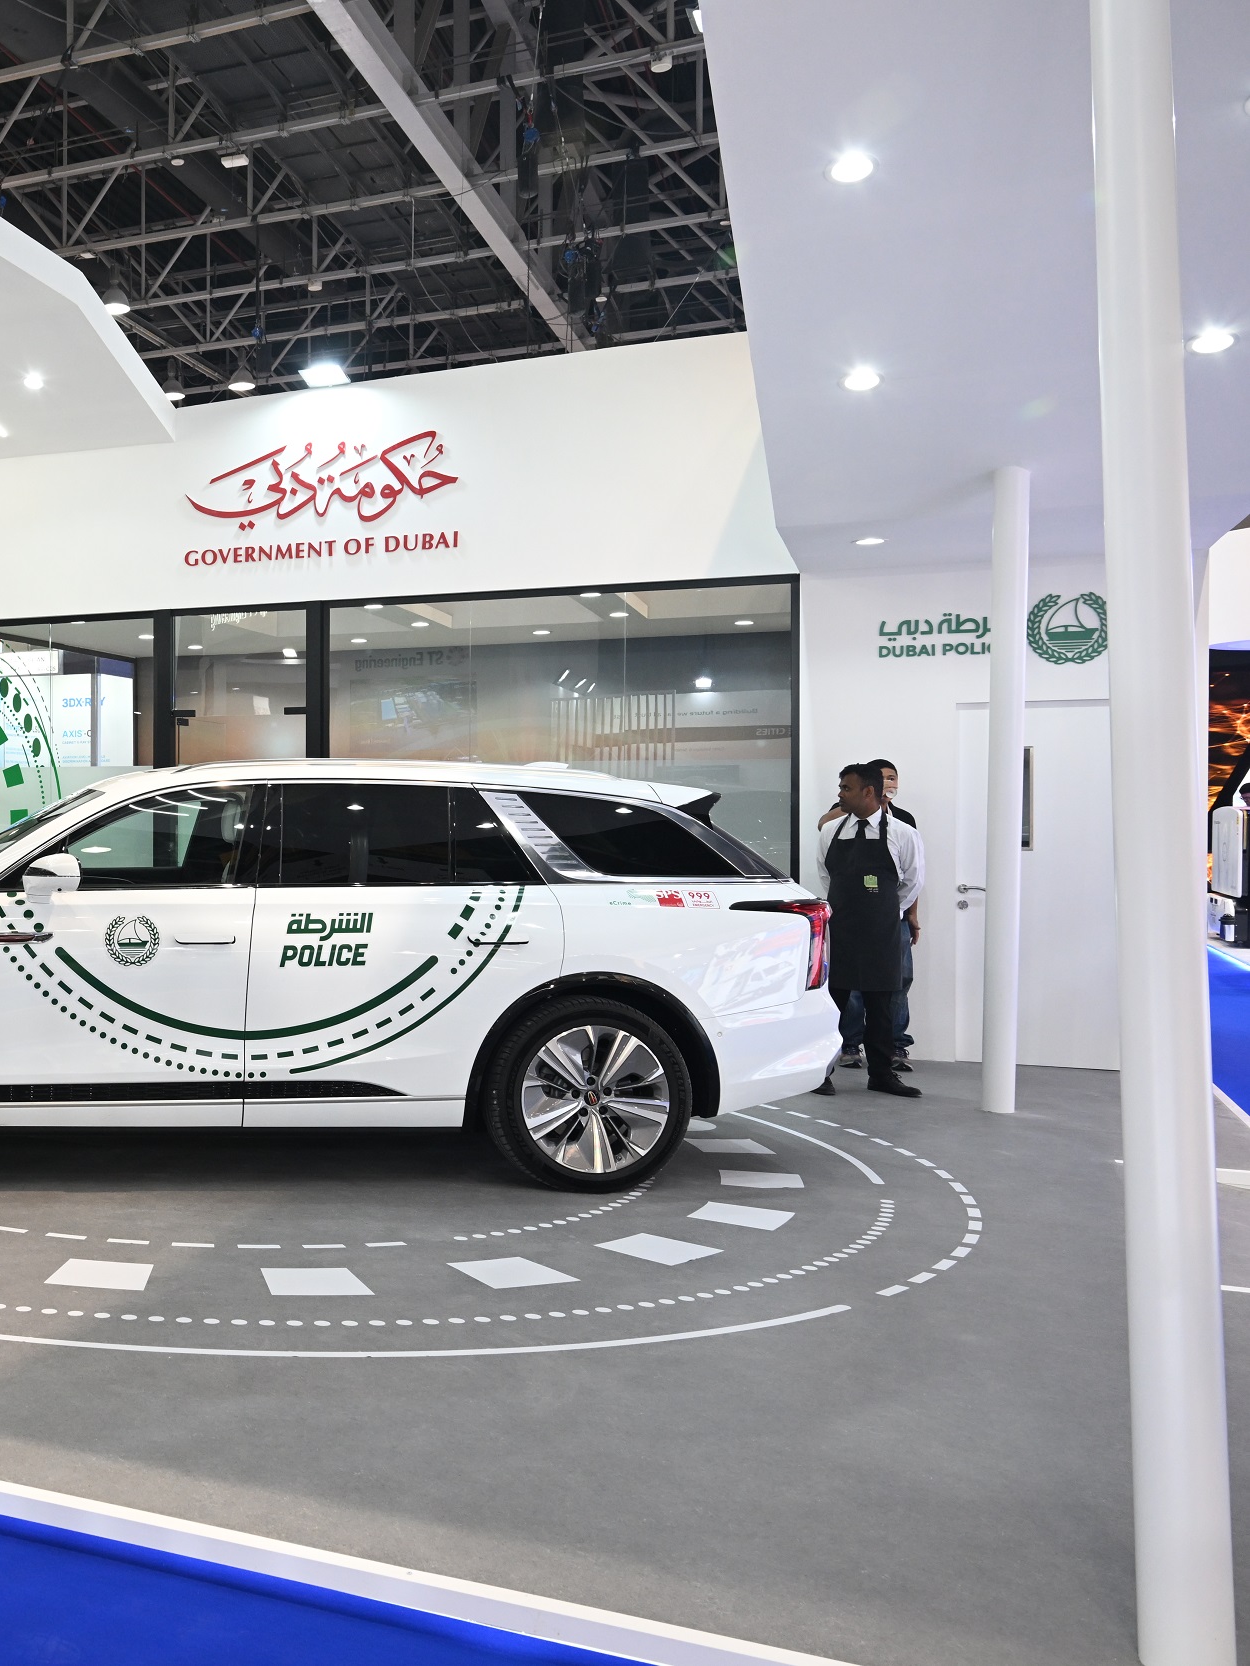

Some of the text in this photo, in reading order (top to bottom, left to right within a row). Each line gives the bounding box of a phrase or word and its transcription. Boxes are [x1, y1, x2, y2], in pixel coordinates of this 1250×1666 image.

[185, 431, 458, 531] حكومة دبي
[184, 530, 459, 567] GOVERNMENT OF DUBAI
[878, 612, 991, 641] رطة دبي
[878, 642, 991, 658] DUBAI POLI
[688, 891, 710, 900] 999
[286, 912, 373, 941] الشرطة
[279, 943, 368, 967] POLICE
